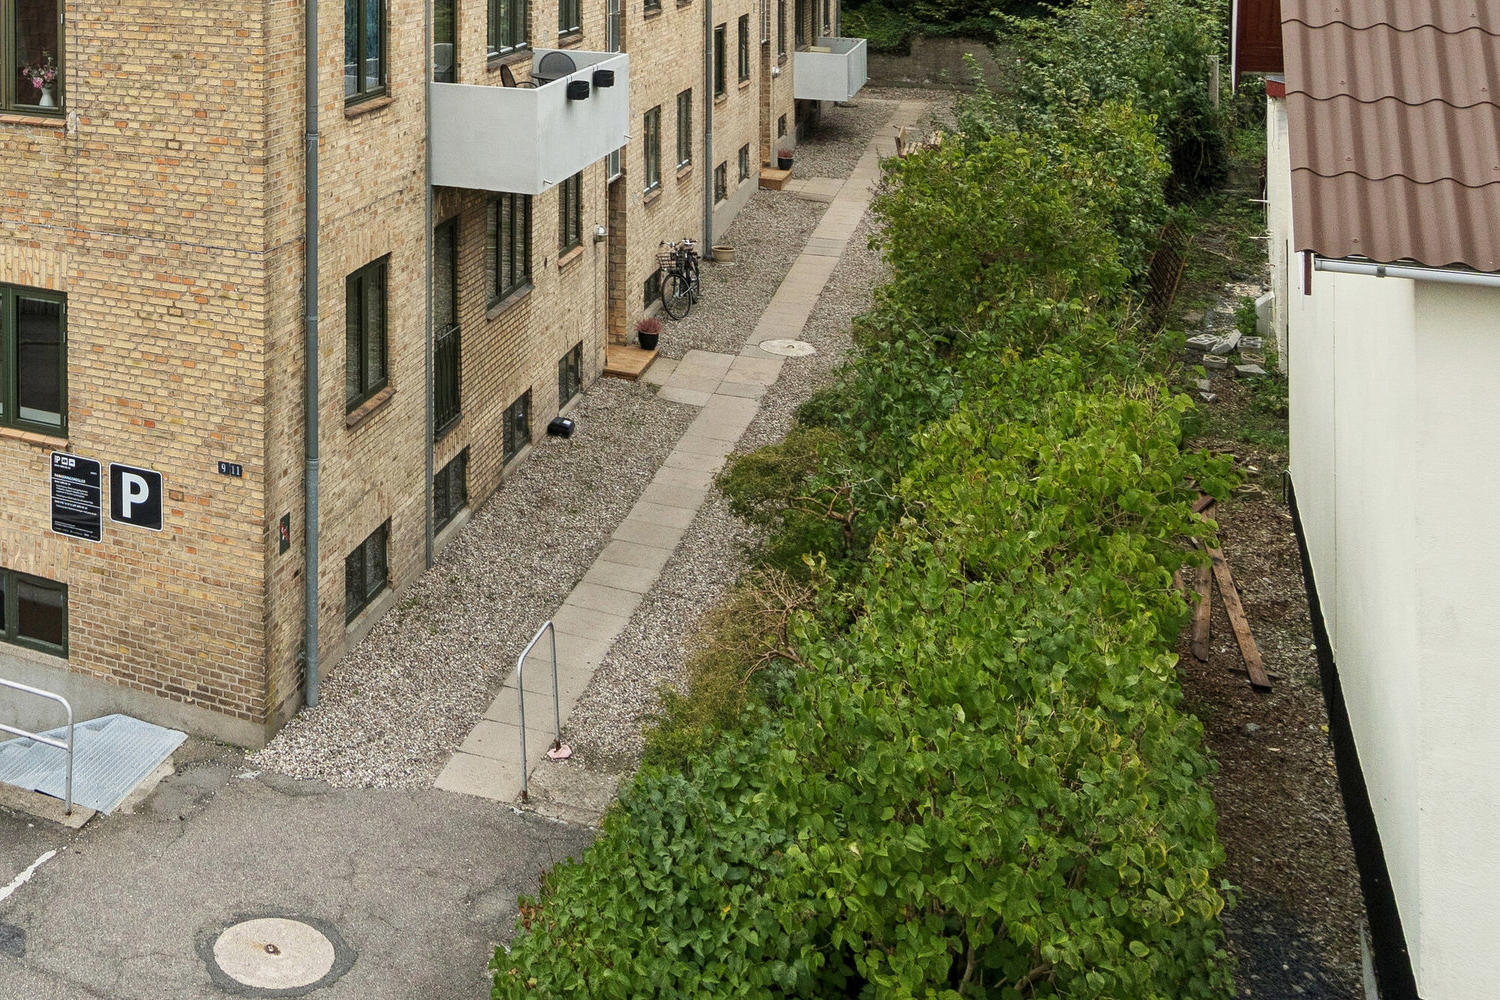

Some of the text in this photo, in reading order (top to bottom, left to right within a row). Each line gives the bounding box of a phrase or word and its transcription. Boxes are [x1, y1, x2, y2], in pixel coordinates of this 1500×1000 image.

[221, 463, 240, 476] 9 11
[121, 471, 150, 519] P
